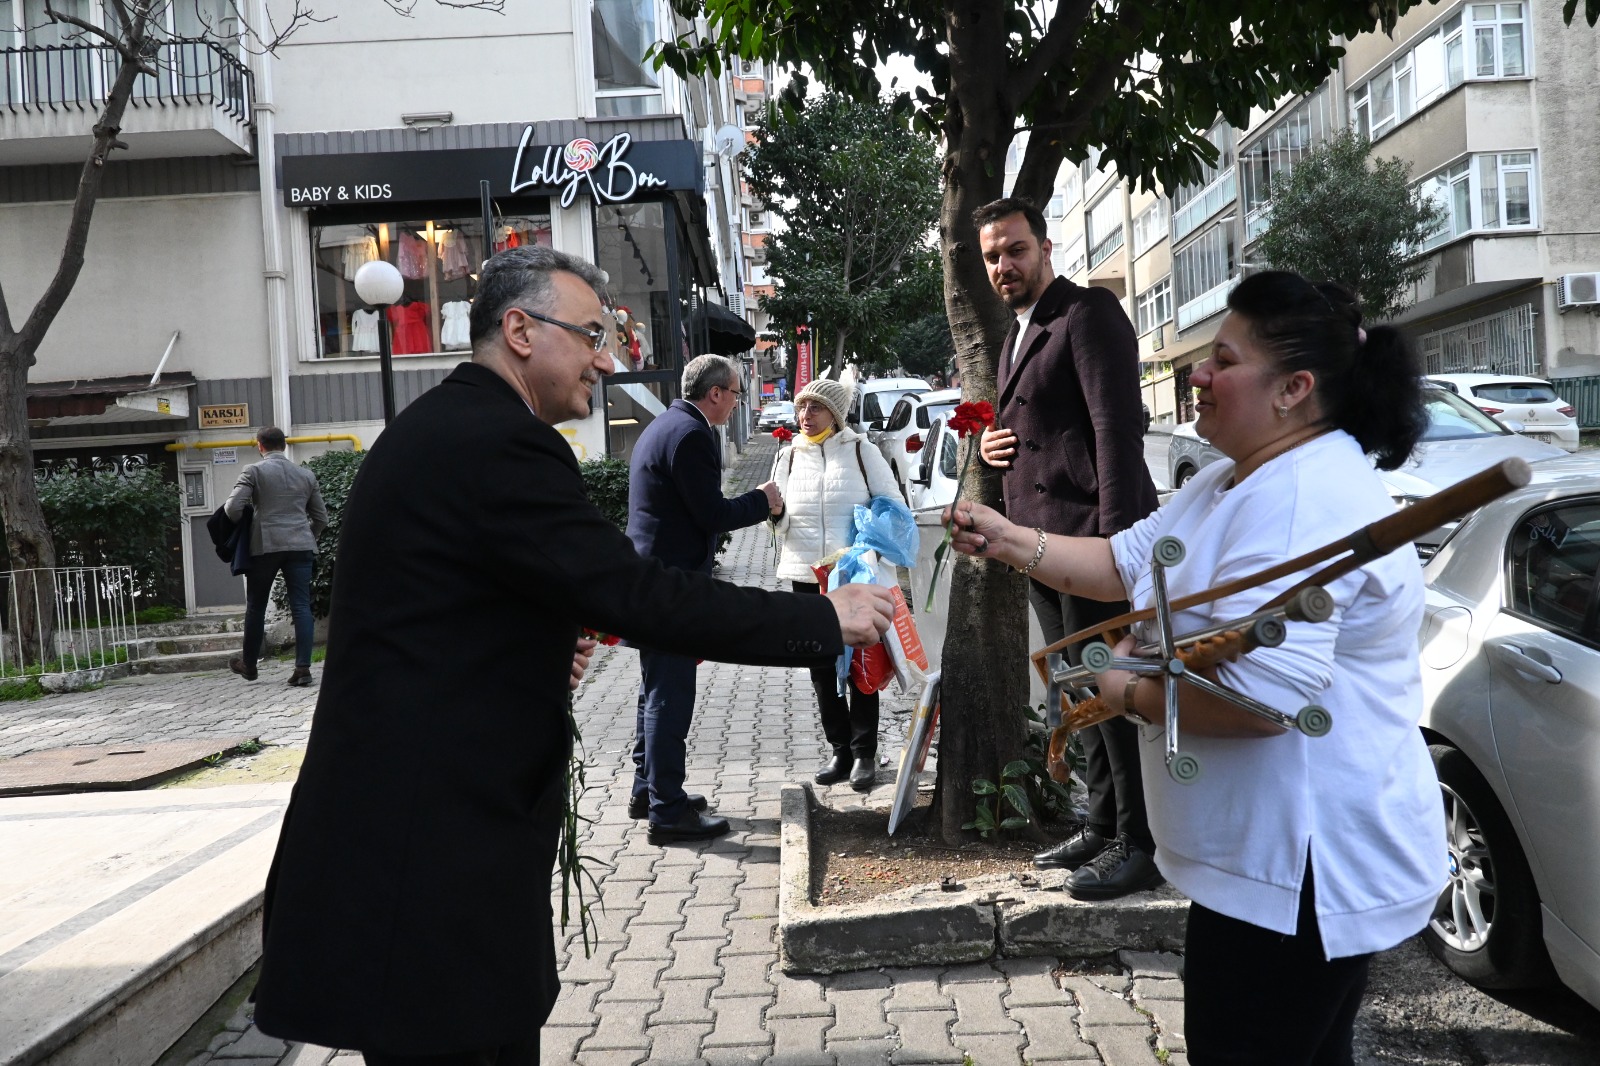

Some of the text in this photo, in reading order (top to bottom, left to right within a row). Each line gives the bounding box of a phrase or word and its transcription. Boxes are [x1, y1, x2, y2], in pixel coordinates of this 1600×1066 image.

[510, 125, 667, 208] Lolly Bon
[291, 183, 393, 203] BABY & KIDS
[203, 408, 244, 419] KARSLI
